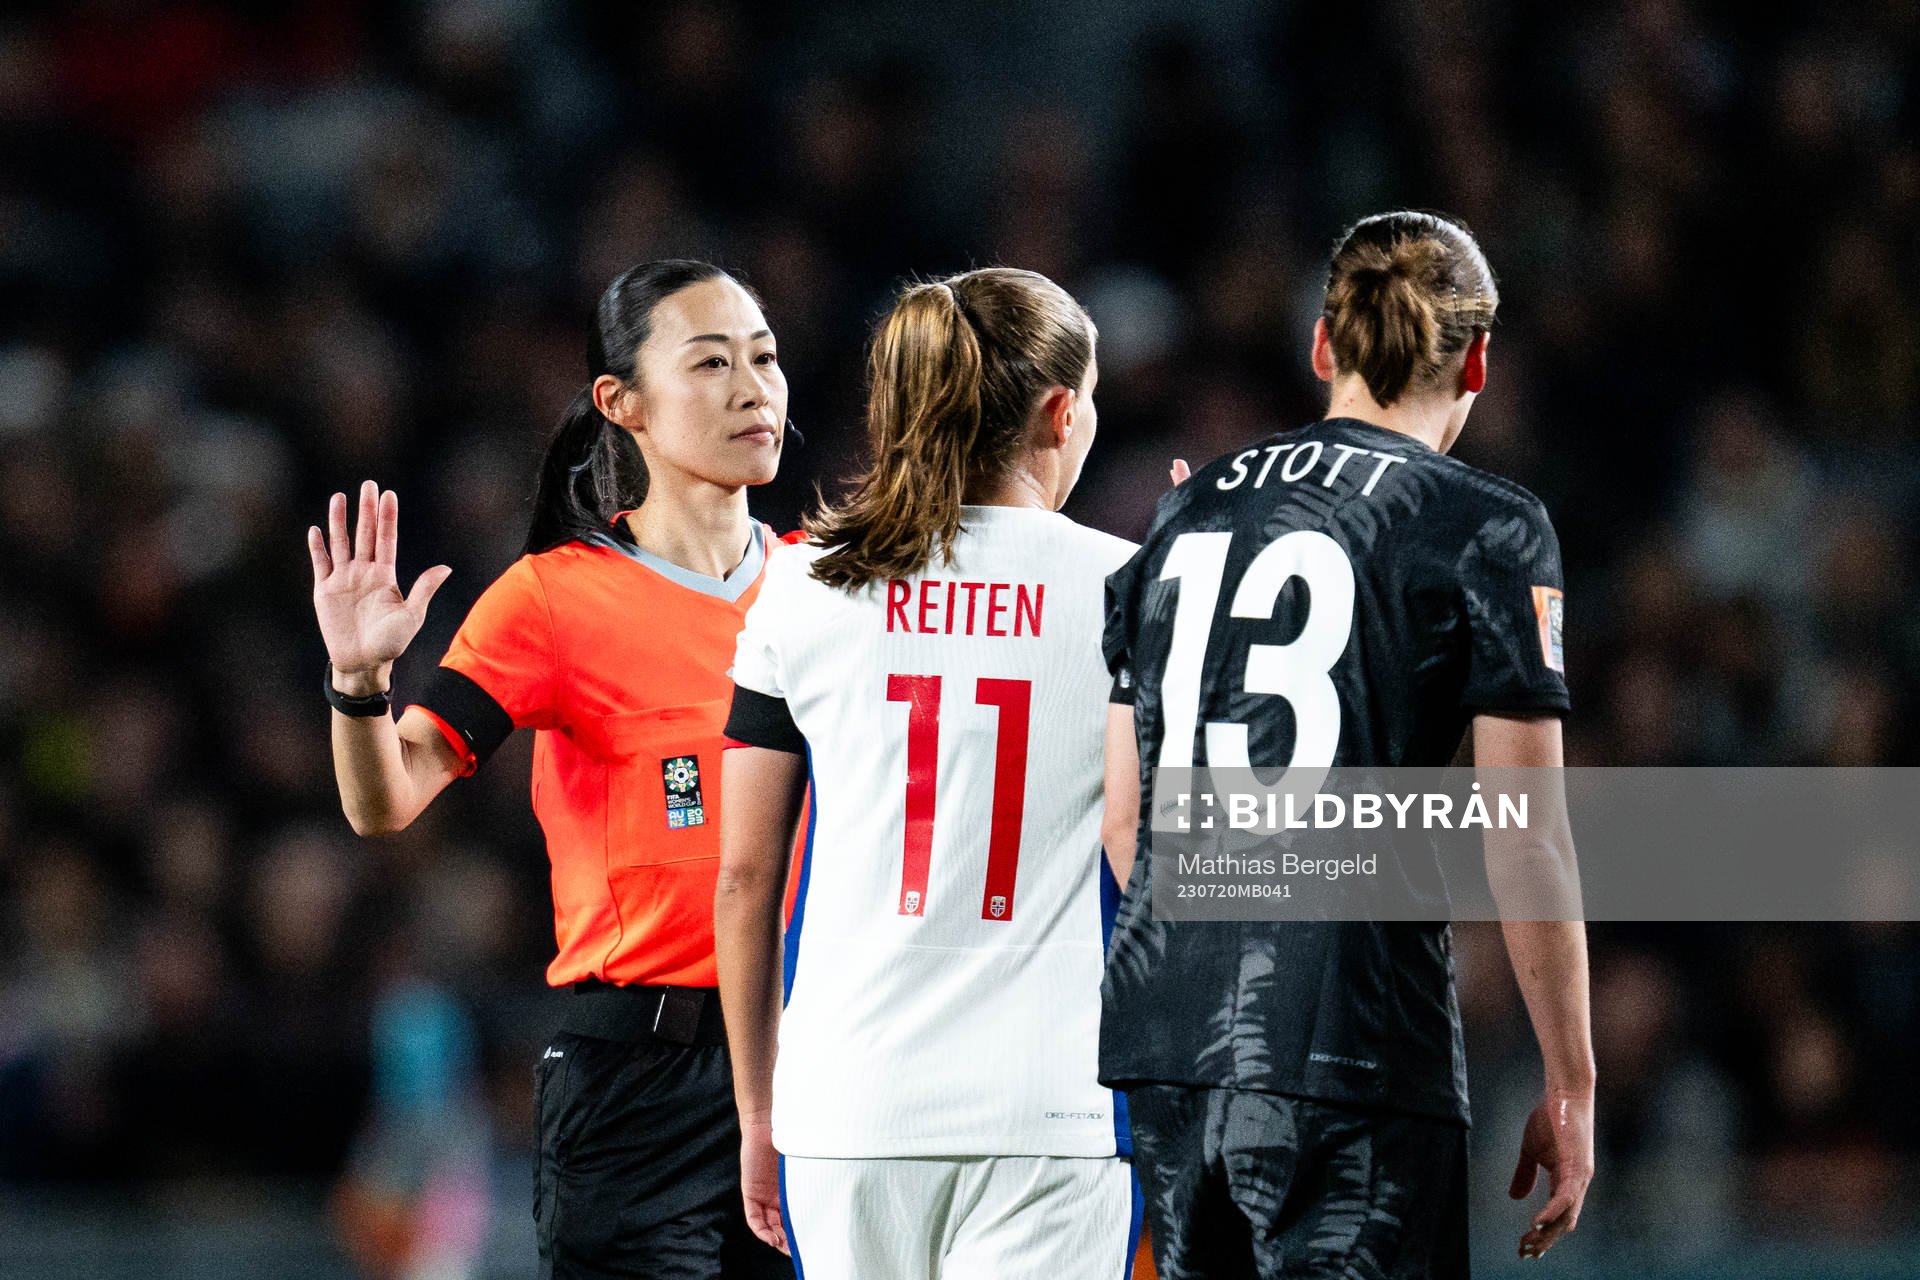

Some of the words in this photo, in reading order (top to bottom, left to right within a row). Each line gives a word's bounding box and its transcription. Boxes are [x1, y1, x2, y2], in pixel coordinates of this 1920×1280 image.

[1216, 440, 1407, 497] STOTT
[886, 579, 1045, 638] REITEN
[1151, 530, 1356, 836] 13
[669, 810, 684, 820] AU
[669, 819, 685, 828] NZ
[687, 808, 703, 817] 20
[887, 673, 1033, 922] 11
